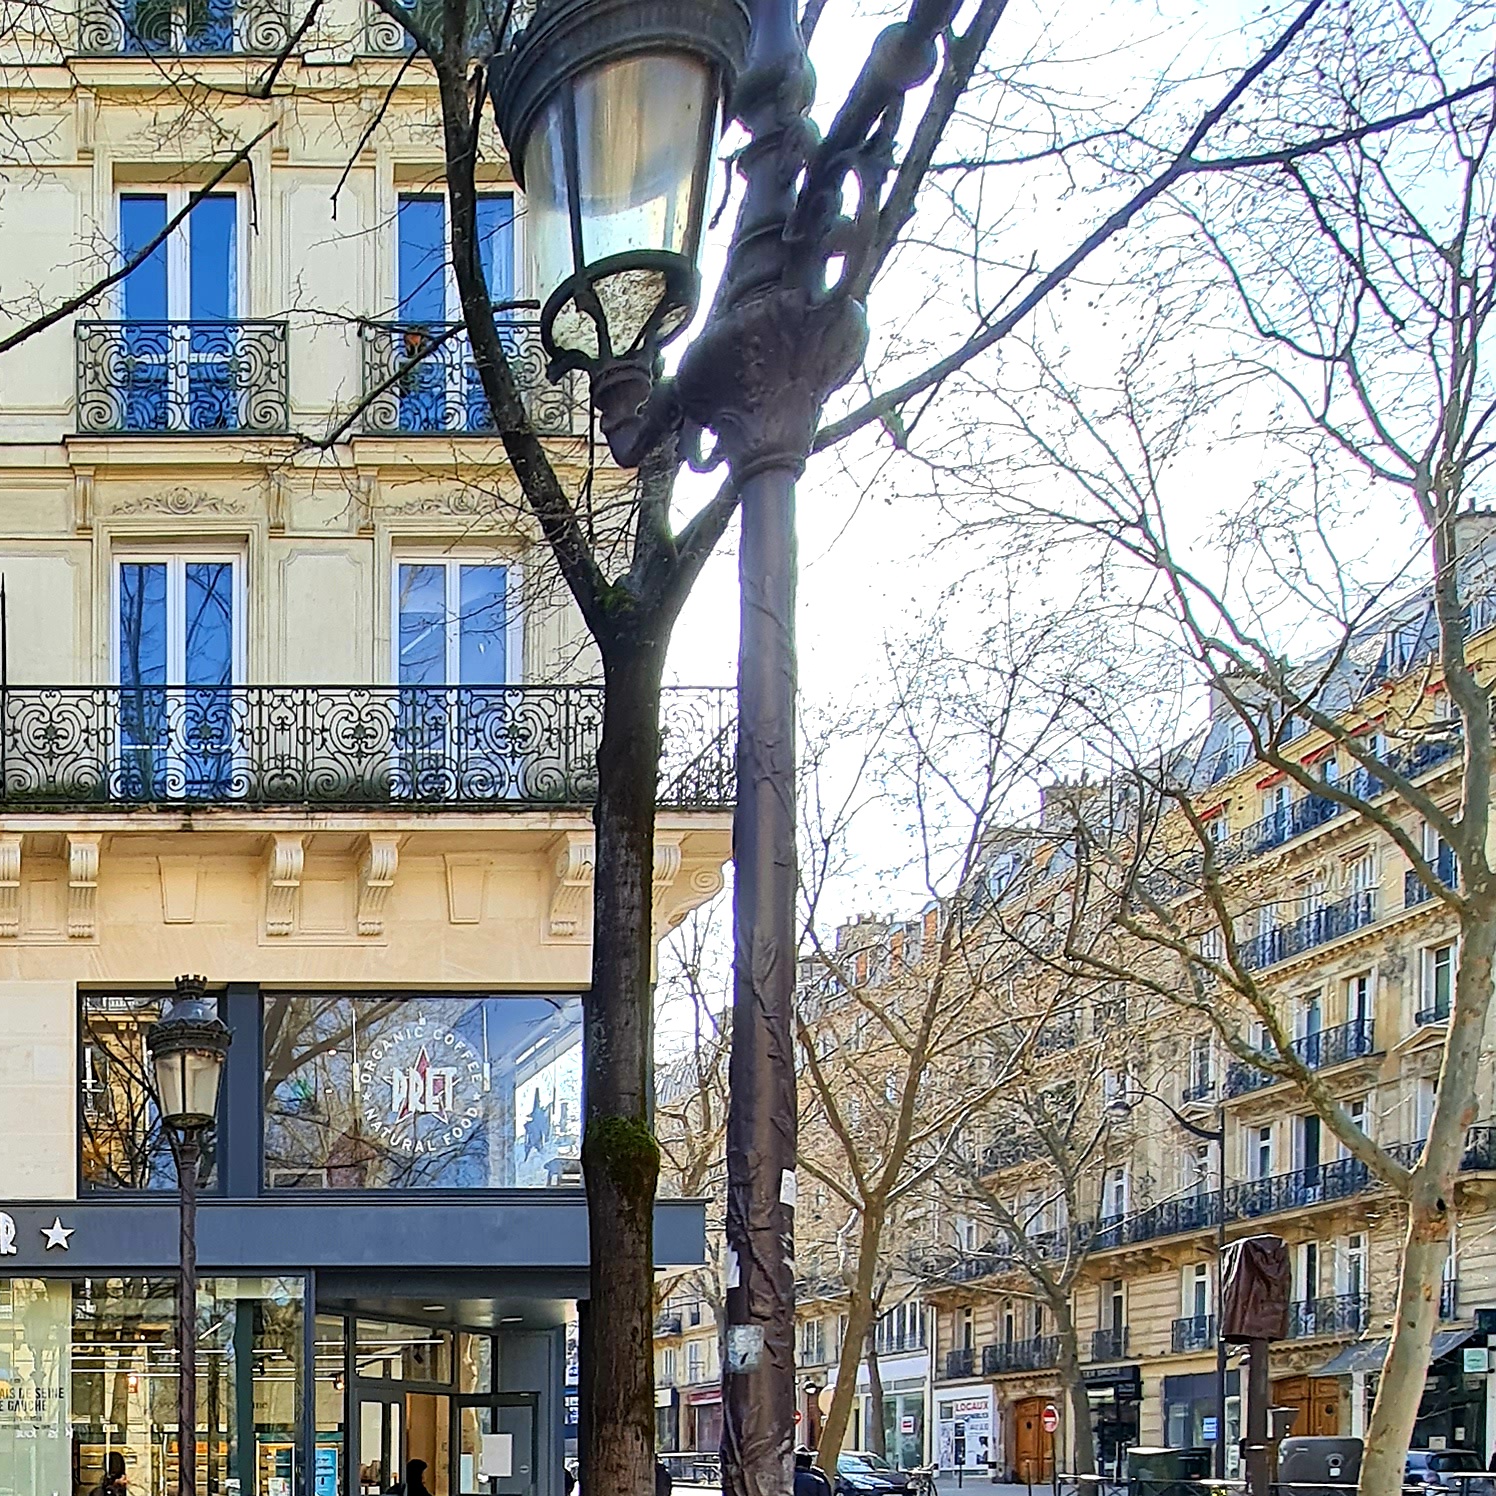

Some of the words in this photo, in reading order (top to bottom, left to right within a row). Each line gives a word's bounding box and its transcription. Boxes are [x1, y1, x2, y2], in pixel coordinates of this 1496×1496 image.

[360, 1026, 425, 1085] ORGANIC
[433, 1029, 483, 1085] COFFEE
[390, 1066, 458, 1113] PRET
[364, 1107, 437, 1153] NATURAL
[442, 1106, 478, 1147] FOOD
[8, 1399, 47, 1413] GAUCHE
